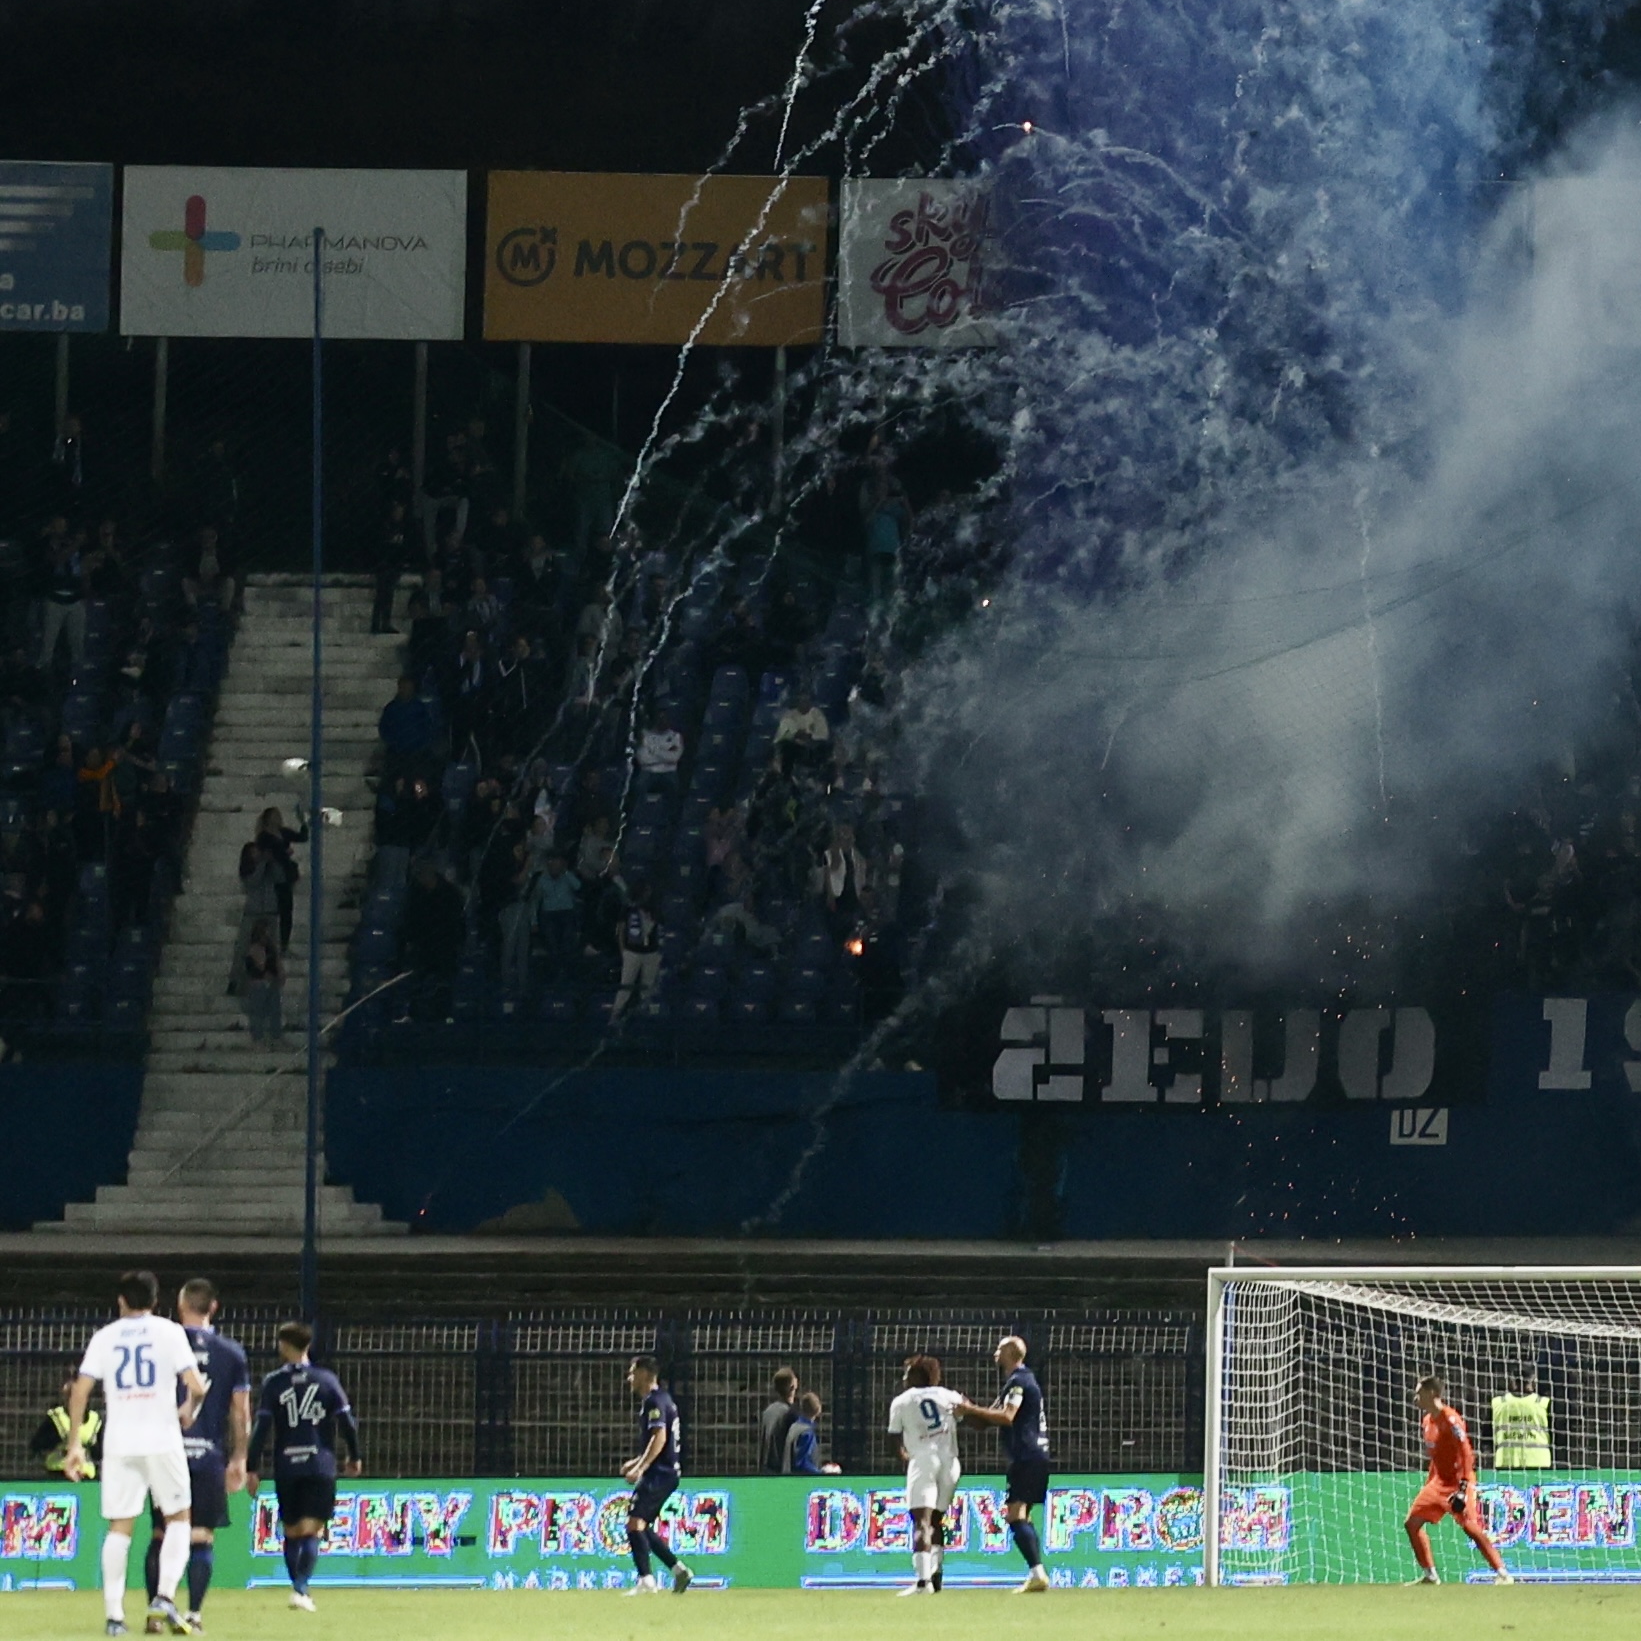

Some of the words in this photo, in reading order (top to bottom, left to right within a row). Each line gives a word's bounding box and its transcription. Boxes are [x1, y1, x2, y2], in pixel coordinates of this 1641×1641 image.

[573, 240, 817, 281] MOZZART
[113, 1344, 156, 1390] 26
[279, 1382, 327, 1428] 14
[919, 1397, 942, 1431] 9
